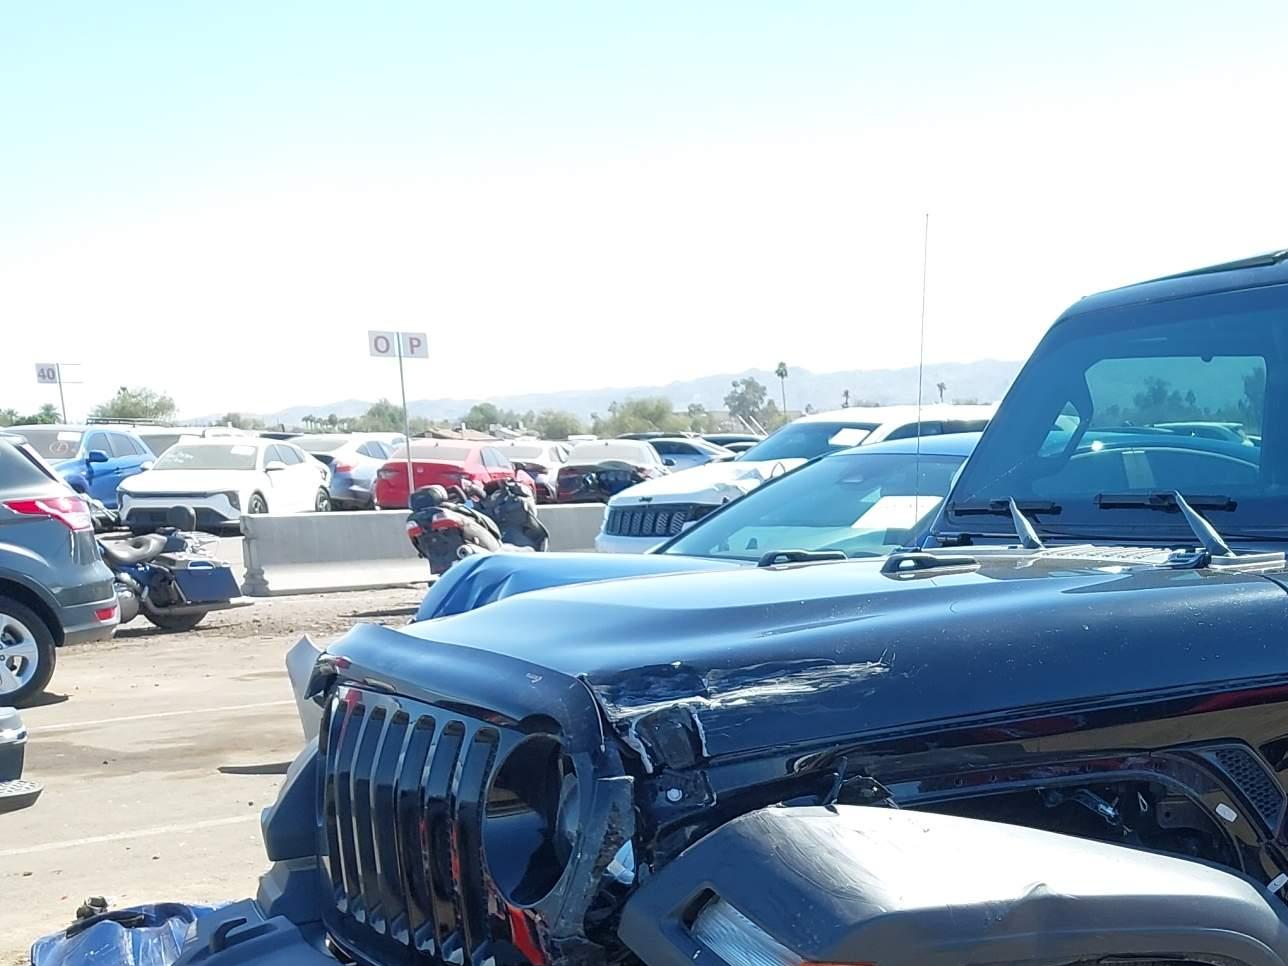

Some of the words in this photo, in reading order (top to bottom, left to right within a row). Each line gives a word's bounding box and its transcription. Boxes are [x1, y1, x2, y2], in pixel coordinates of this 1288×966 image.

[374, 335, 390, 353] O
[409, 337, 421, 355] P
[38, 367, 56, 380] 40
